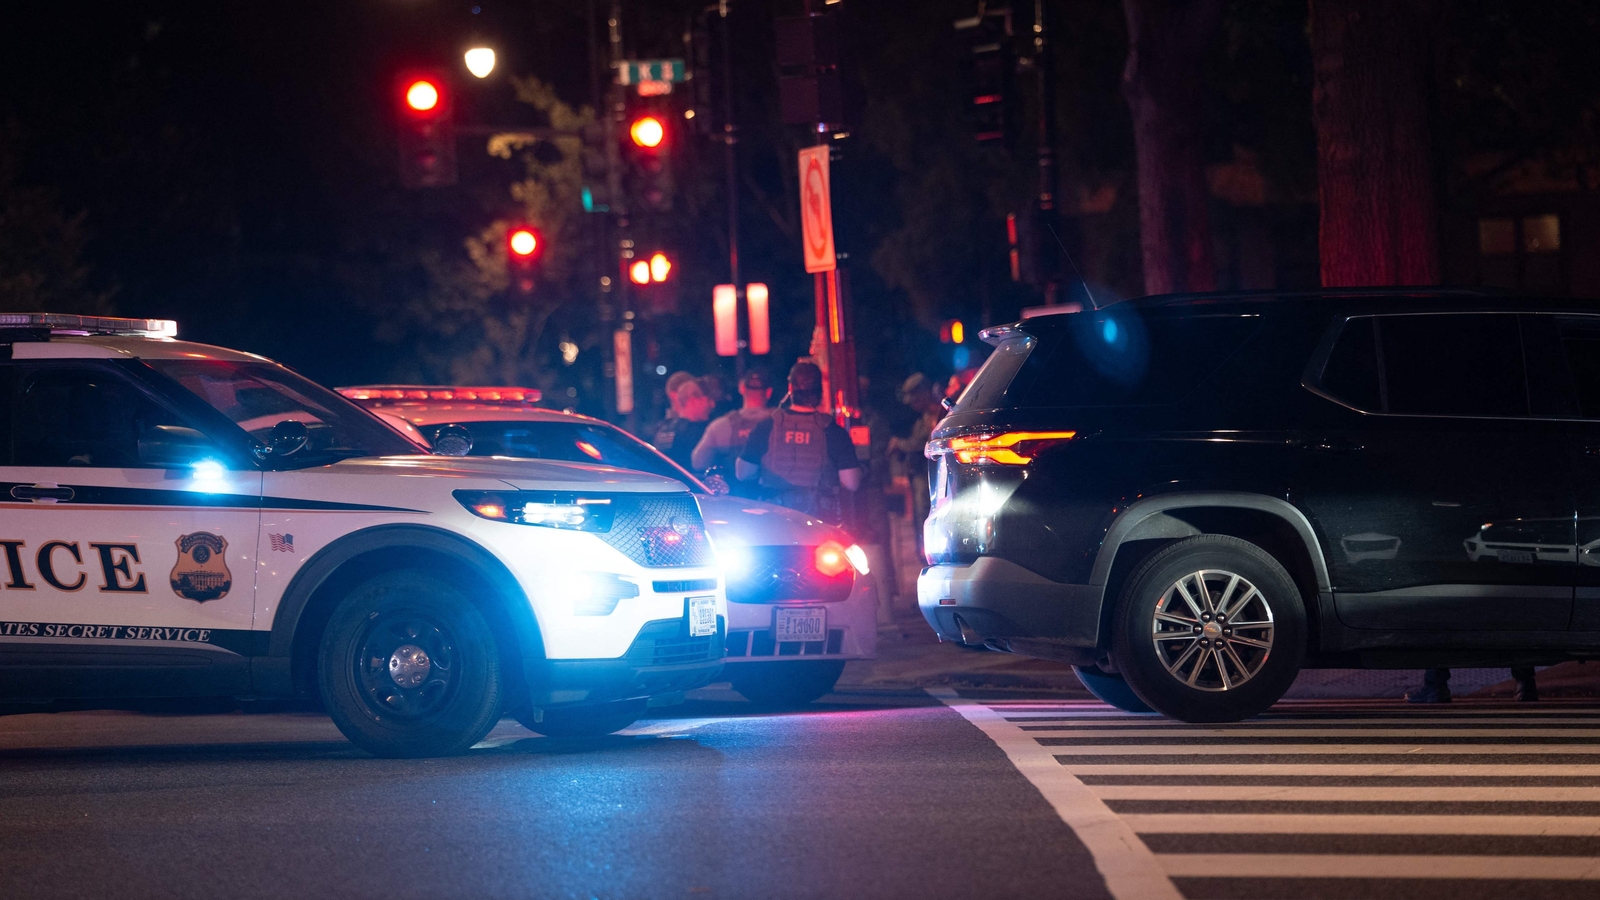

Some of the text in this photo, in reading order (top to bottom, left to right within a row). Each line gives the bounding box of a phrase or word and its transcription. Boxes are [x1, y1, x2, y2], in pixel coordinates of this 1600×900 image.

[785, 431, 810, 444] FBI
[43, 624, 121, 639] SECRET
[124, 627, 211, 642] SERVICE
